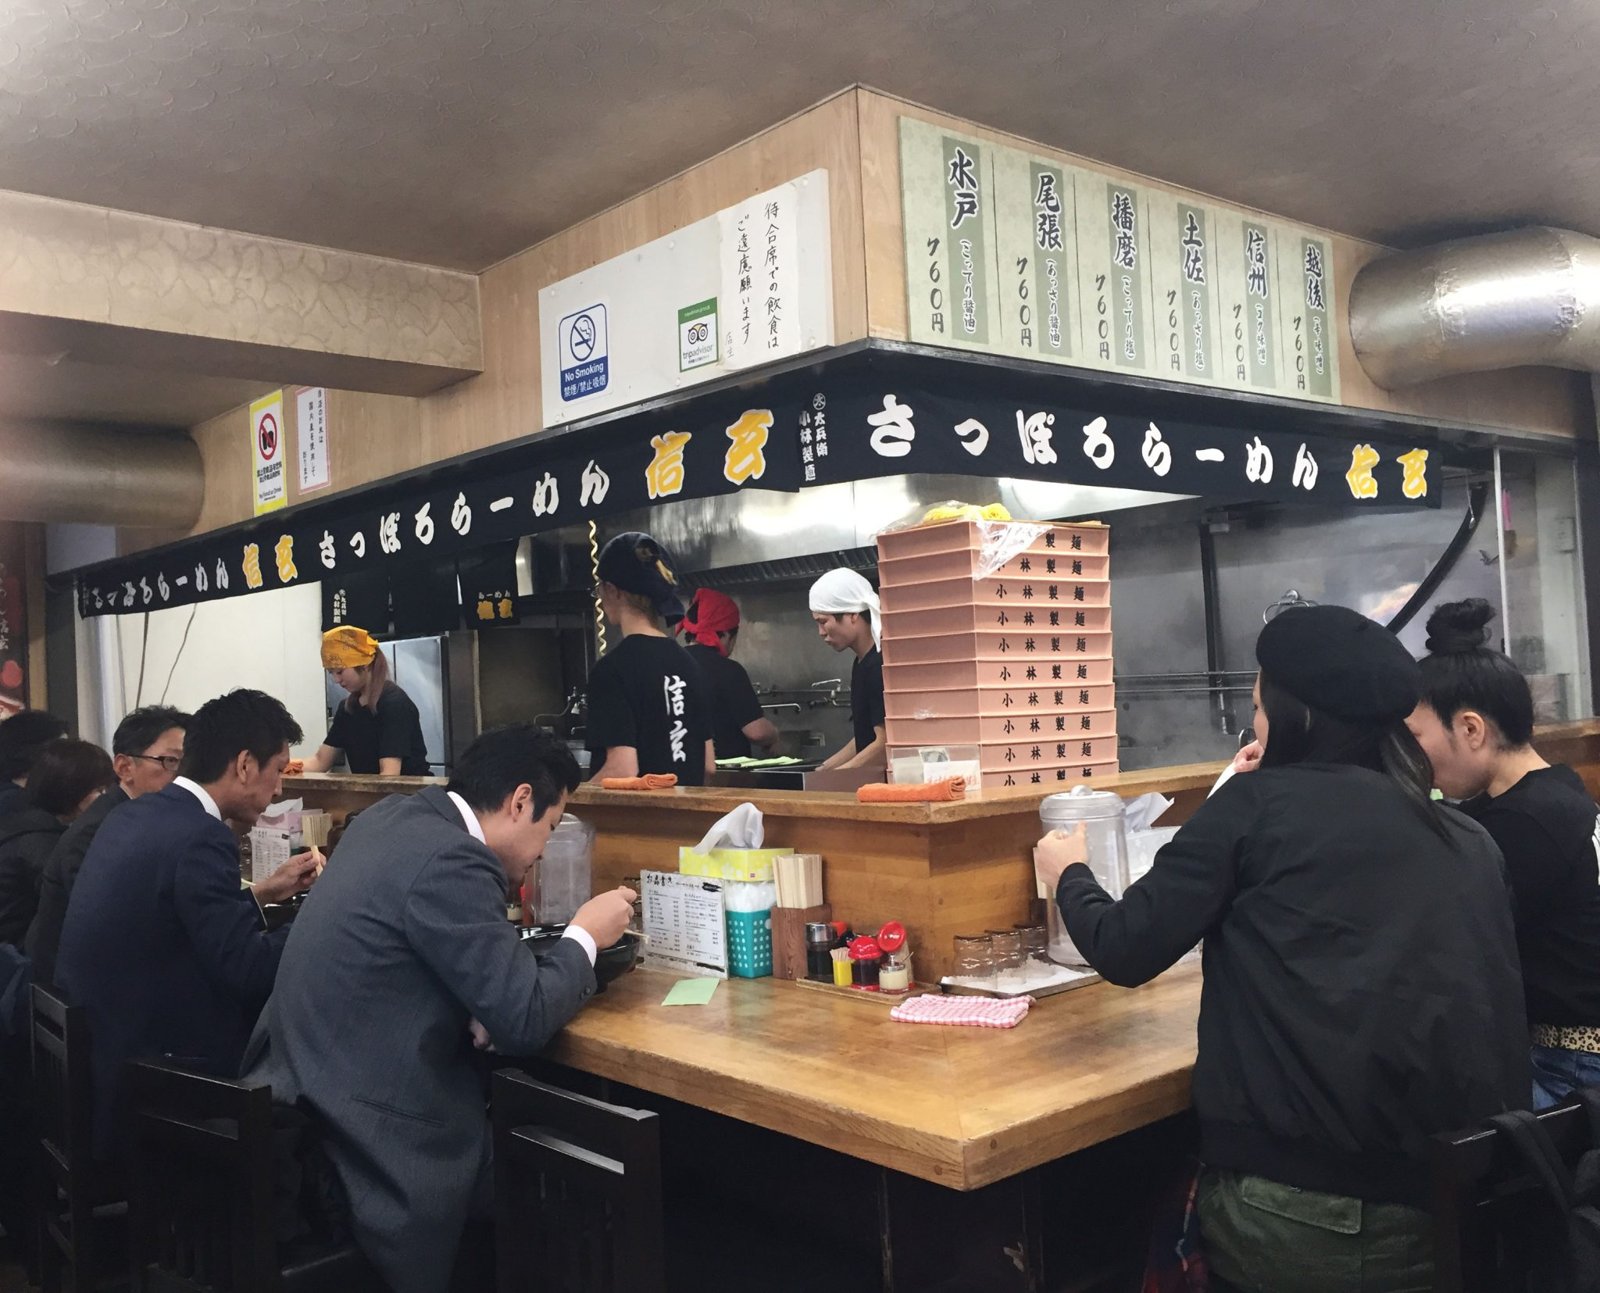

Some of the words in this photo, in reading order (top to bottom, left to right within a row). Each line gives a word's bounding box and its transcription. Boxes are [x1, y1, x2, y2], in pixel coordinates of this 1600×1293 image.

[949, 147, 977, 228] 水戸
[1035, 174, 1062, 251] 尾張
[1112, 192, 1136, 270] 播磨
[1182, 211, 1205, 285] 土佐
[1246, 228, 1268, 299] 信州
[737, 214, 752, 345] ご遠慮願います
[764, 201, 782, 349] 待合席での飲食は
[927, 237, 944, 334] 760円
[1016, 256, 1033, 348] 760円
[1304, 245, 1325, 312] 越後
[683, 344, 713, 359] tripadvisor
[1095, 274, 1110, 360] 760円
[1166, 289, 1180, 371] 760円
[1233, 303, 1246, 382] 760円
[1293, 316, 1305, 390] 760円
[565, 372, 574, 382] No
[575, 363, 604, 379] Smoking
[866, 394, 1319, 491] さっぽろらーめん
[319, 459, 610, 569] さっぽろらーめん
[996, 583, 1084, 601] 小林製麺
[997, 557, 1082, 575] 林製麺
[997, 611, 1085, 626] 小林製麺
[999, 637, 1086, 653] 小林製麺
[1000, 664, 1087, 681] 小林製麺
[1002, 689, 1089, 708] 小林製麺
[664, 675, 688, 762] 信玄
[1003, 715, 1091, 734] 小林製麺
[1005, 742, 1092, 763] 小林製麺
